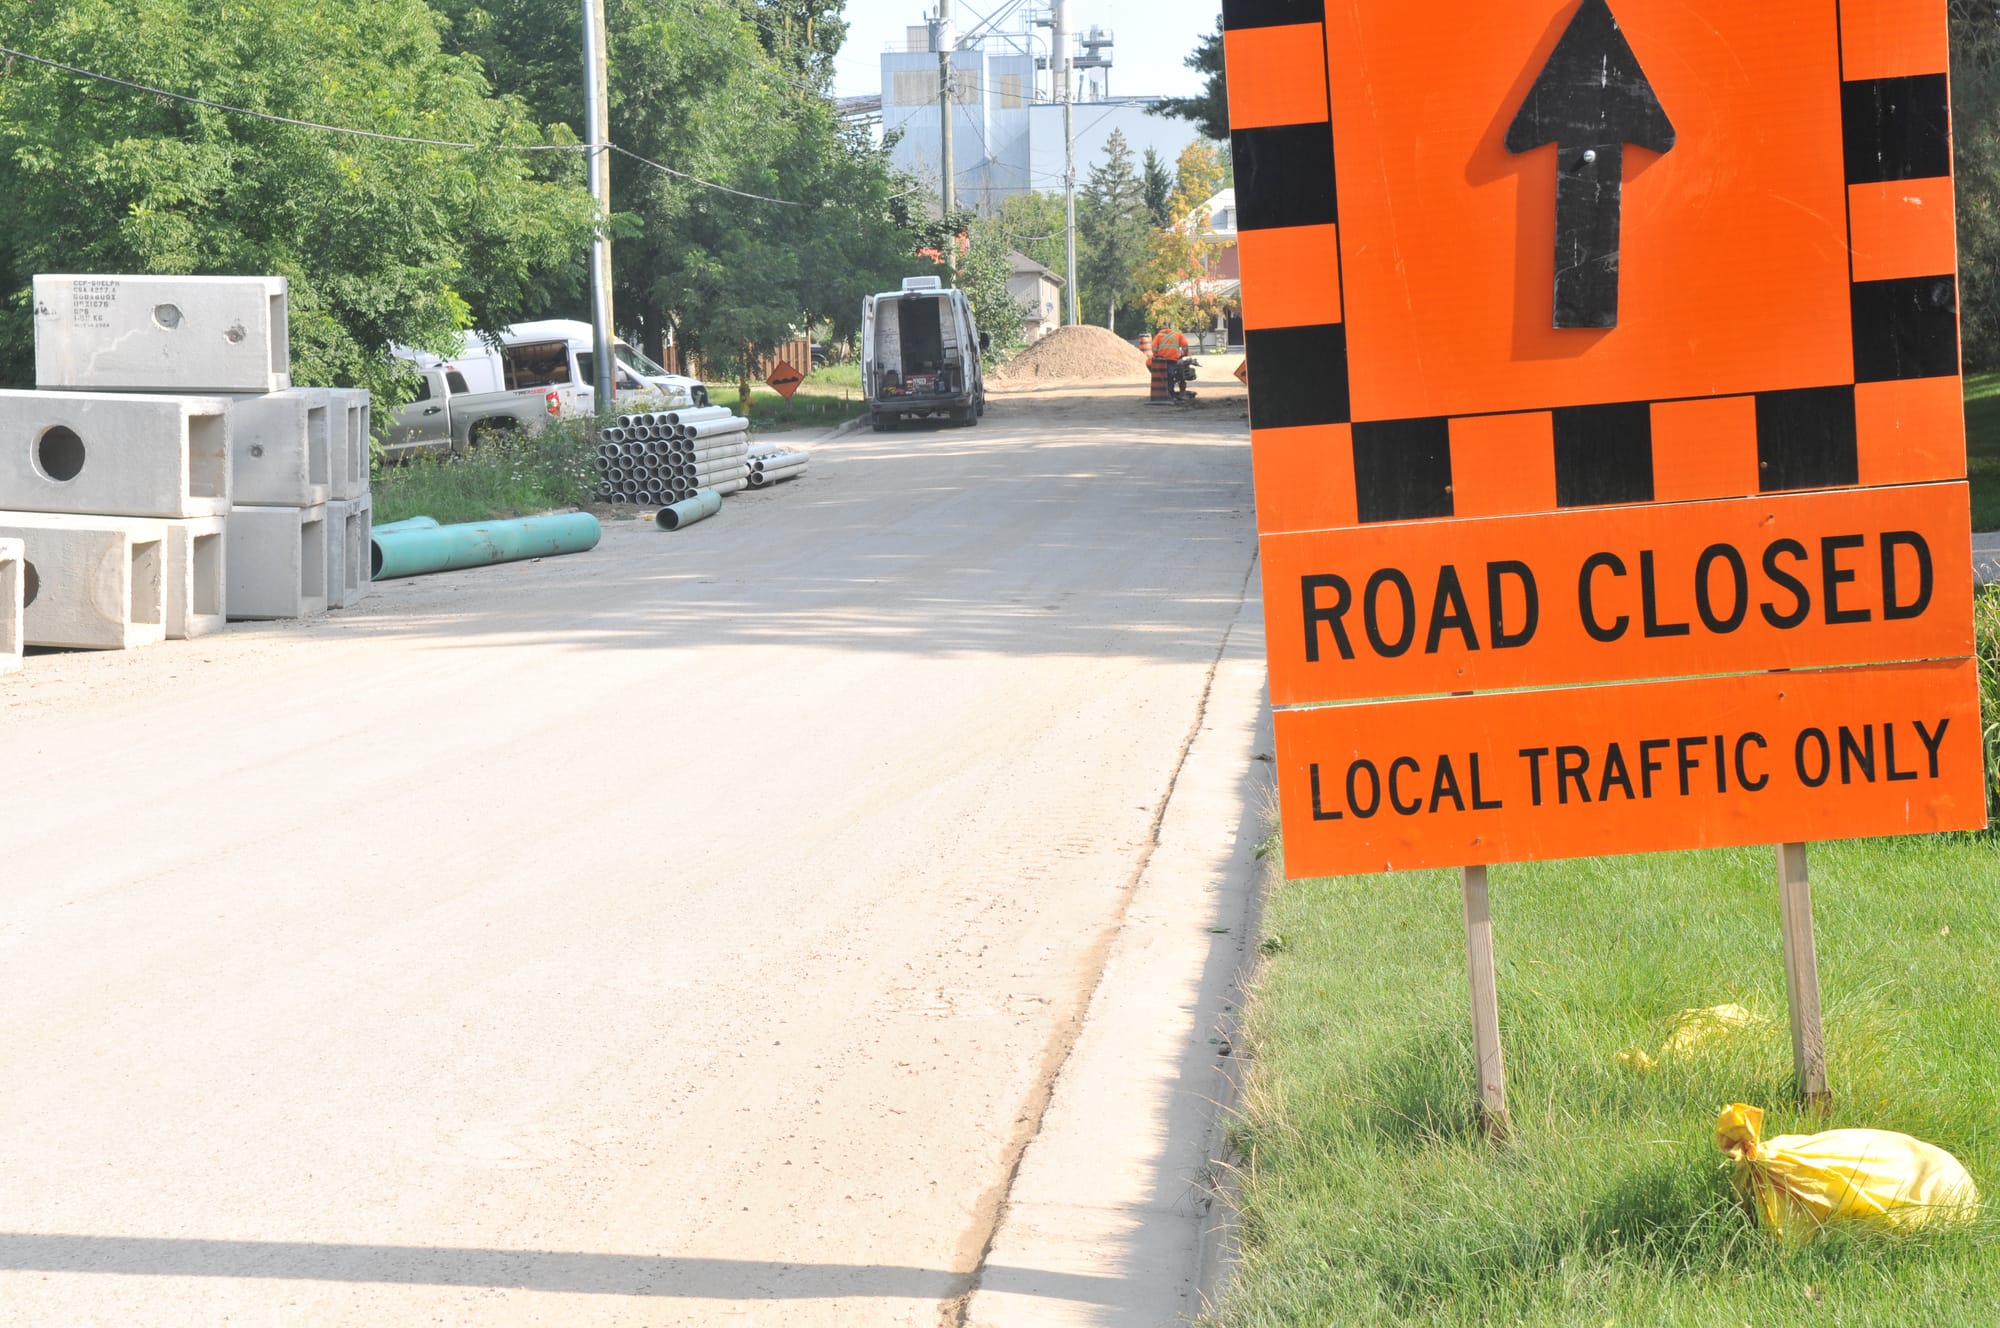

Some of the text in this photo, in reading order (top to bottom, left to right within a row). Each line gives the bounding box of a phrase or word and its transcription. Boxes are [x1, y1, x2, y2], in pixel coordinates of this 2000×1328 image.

[1301, 531, 1933, 662] ROAD CLOSED
[1310, 719, 1949, 821] LOCAL TRAFFIC ONLY
